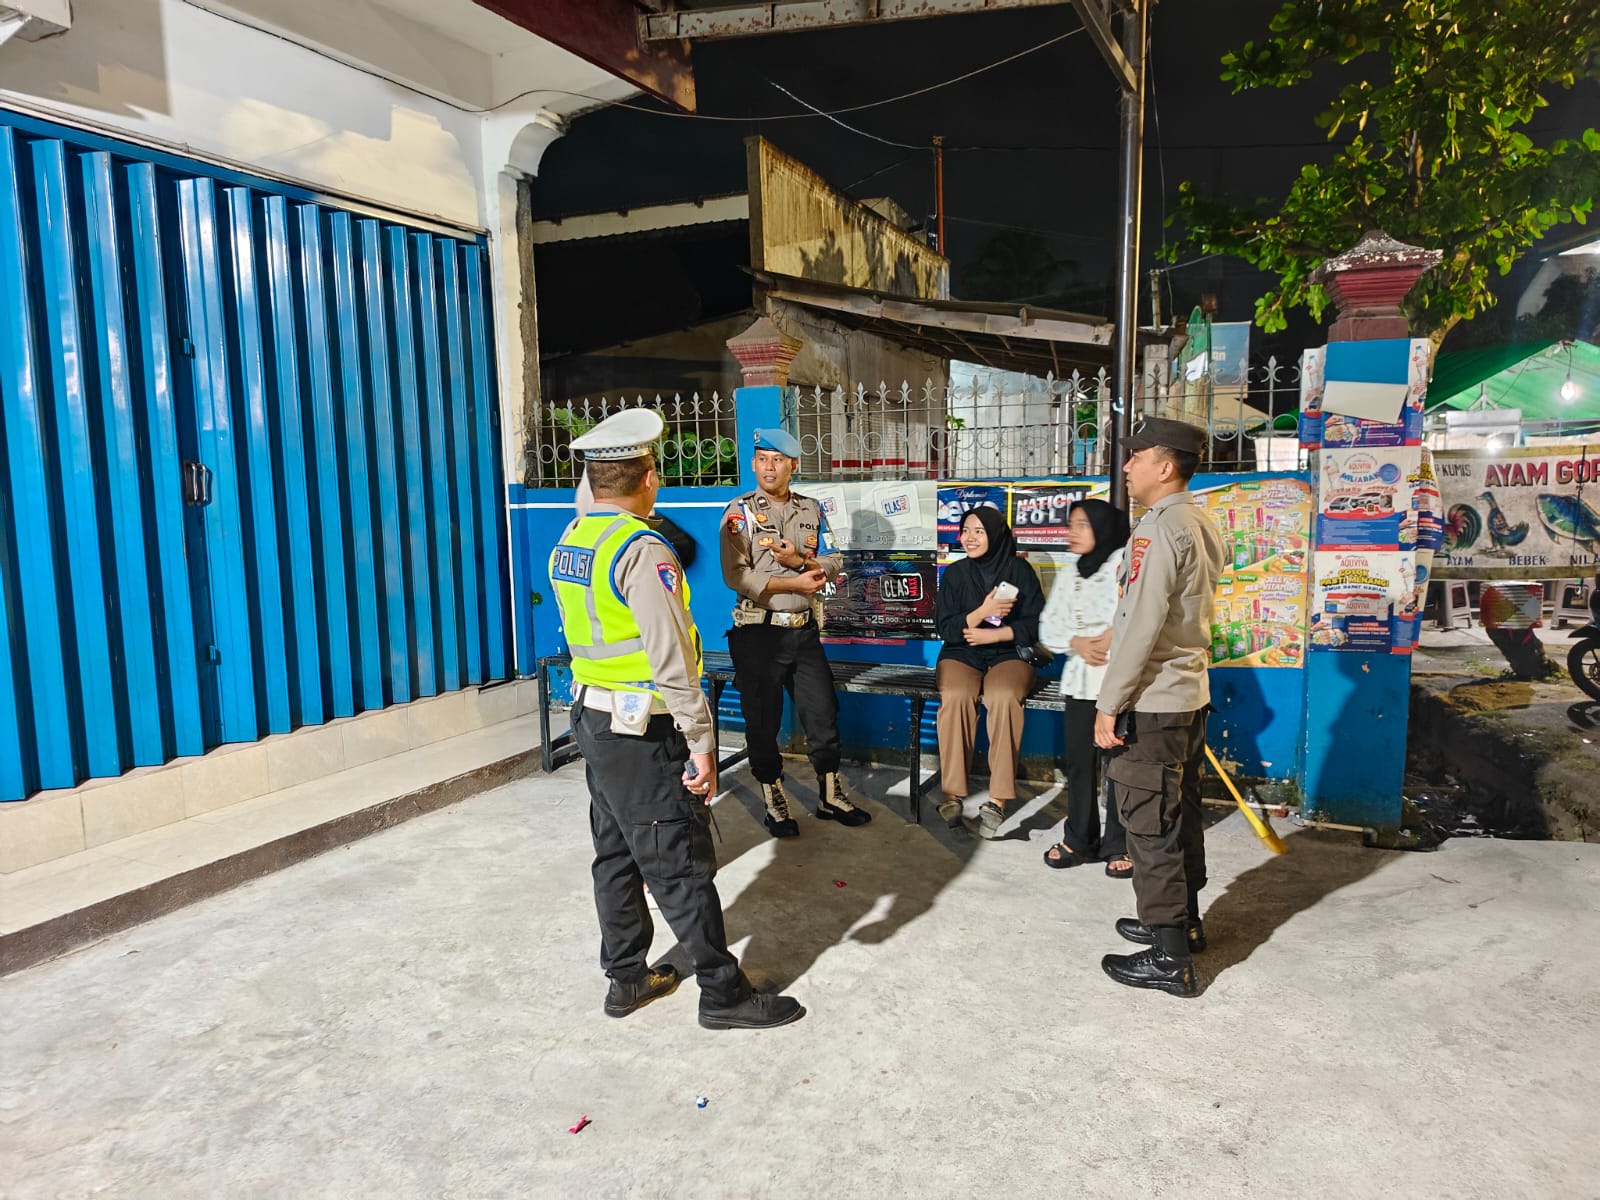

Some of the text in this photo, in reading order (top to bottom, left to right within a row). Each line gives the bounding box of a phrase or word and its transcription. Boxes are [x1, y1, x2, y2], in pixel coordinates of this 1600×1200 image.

[1442, 463, 1471, 477] KUMIS
[1485, 461, 1548, 487] AYAM
[884, 497, 901, 515] CLAS
[1017, 491, 1082, 511] NATION
[554, 550, 592, 579] POLISI
[1447, 557, 1473, 566] AYAM
[1509, 556, 1546, 566] BEBEK
[884, 577, 909, 598] CLAS
